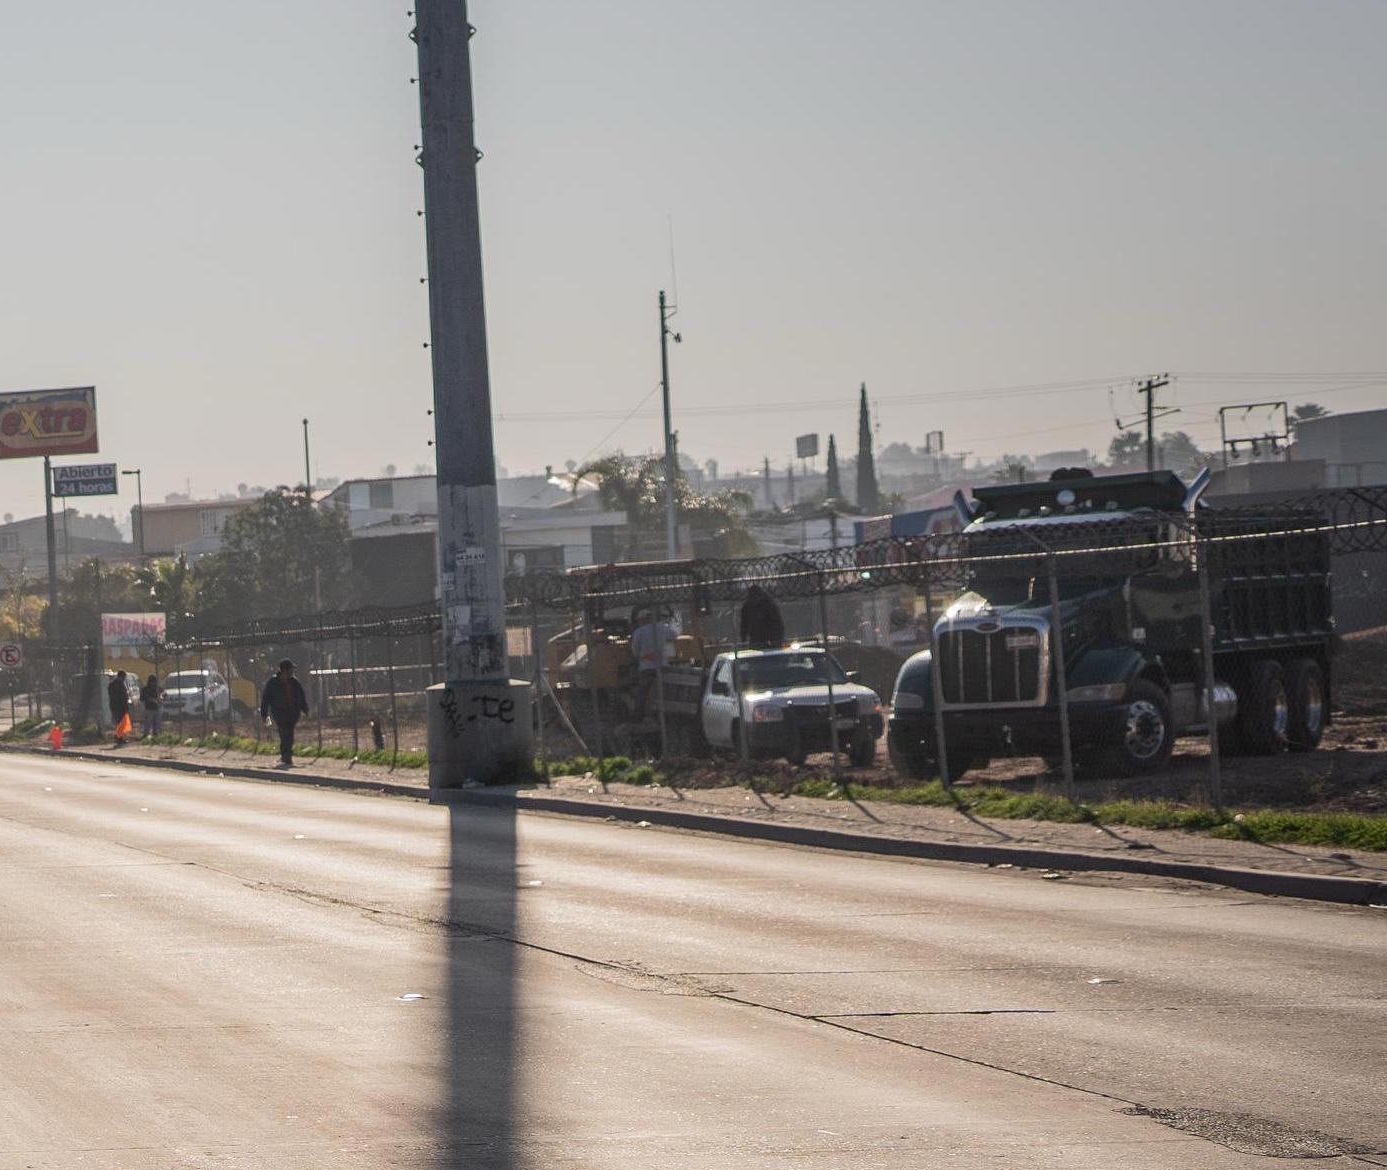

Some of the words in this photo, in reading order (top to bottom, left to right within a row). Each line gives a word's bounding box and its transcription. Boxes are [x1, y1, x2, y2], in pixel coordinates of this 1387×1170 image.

[1, 406, 87, 440] extra
[59, 466, 112, 479] Abierto
[60, 483, 76, 494] 24
[79, 481, 114, 493] horas
